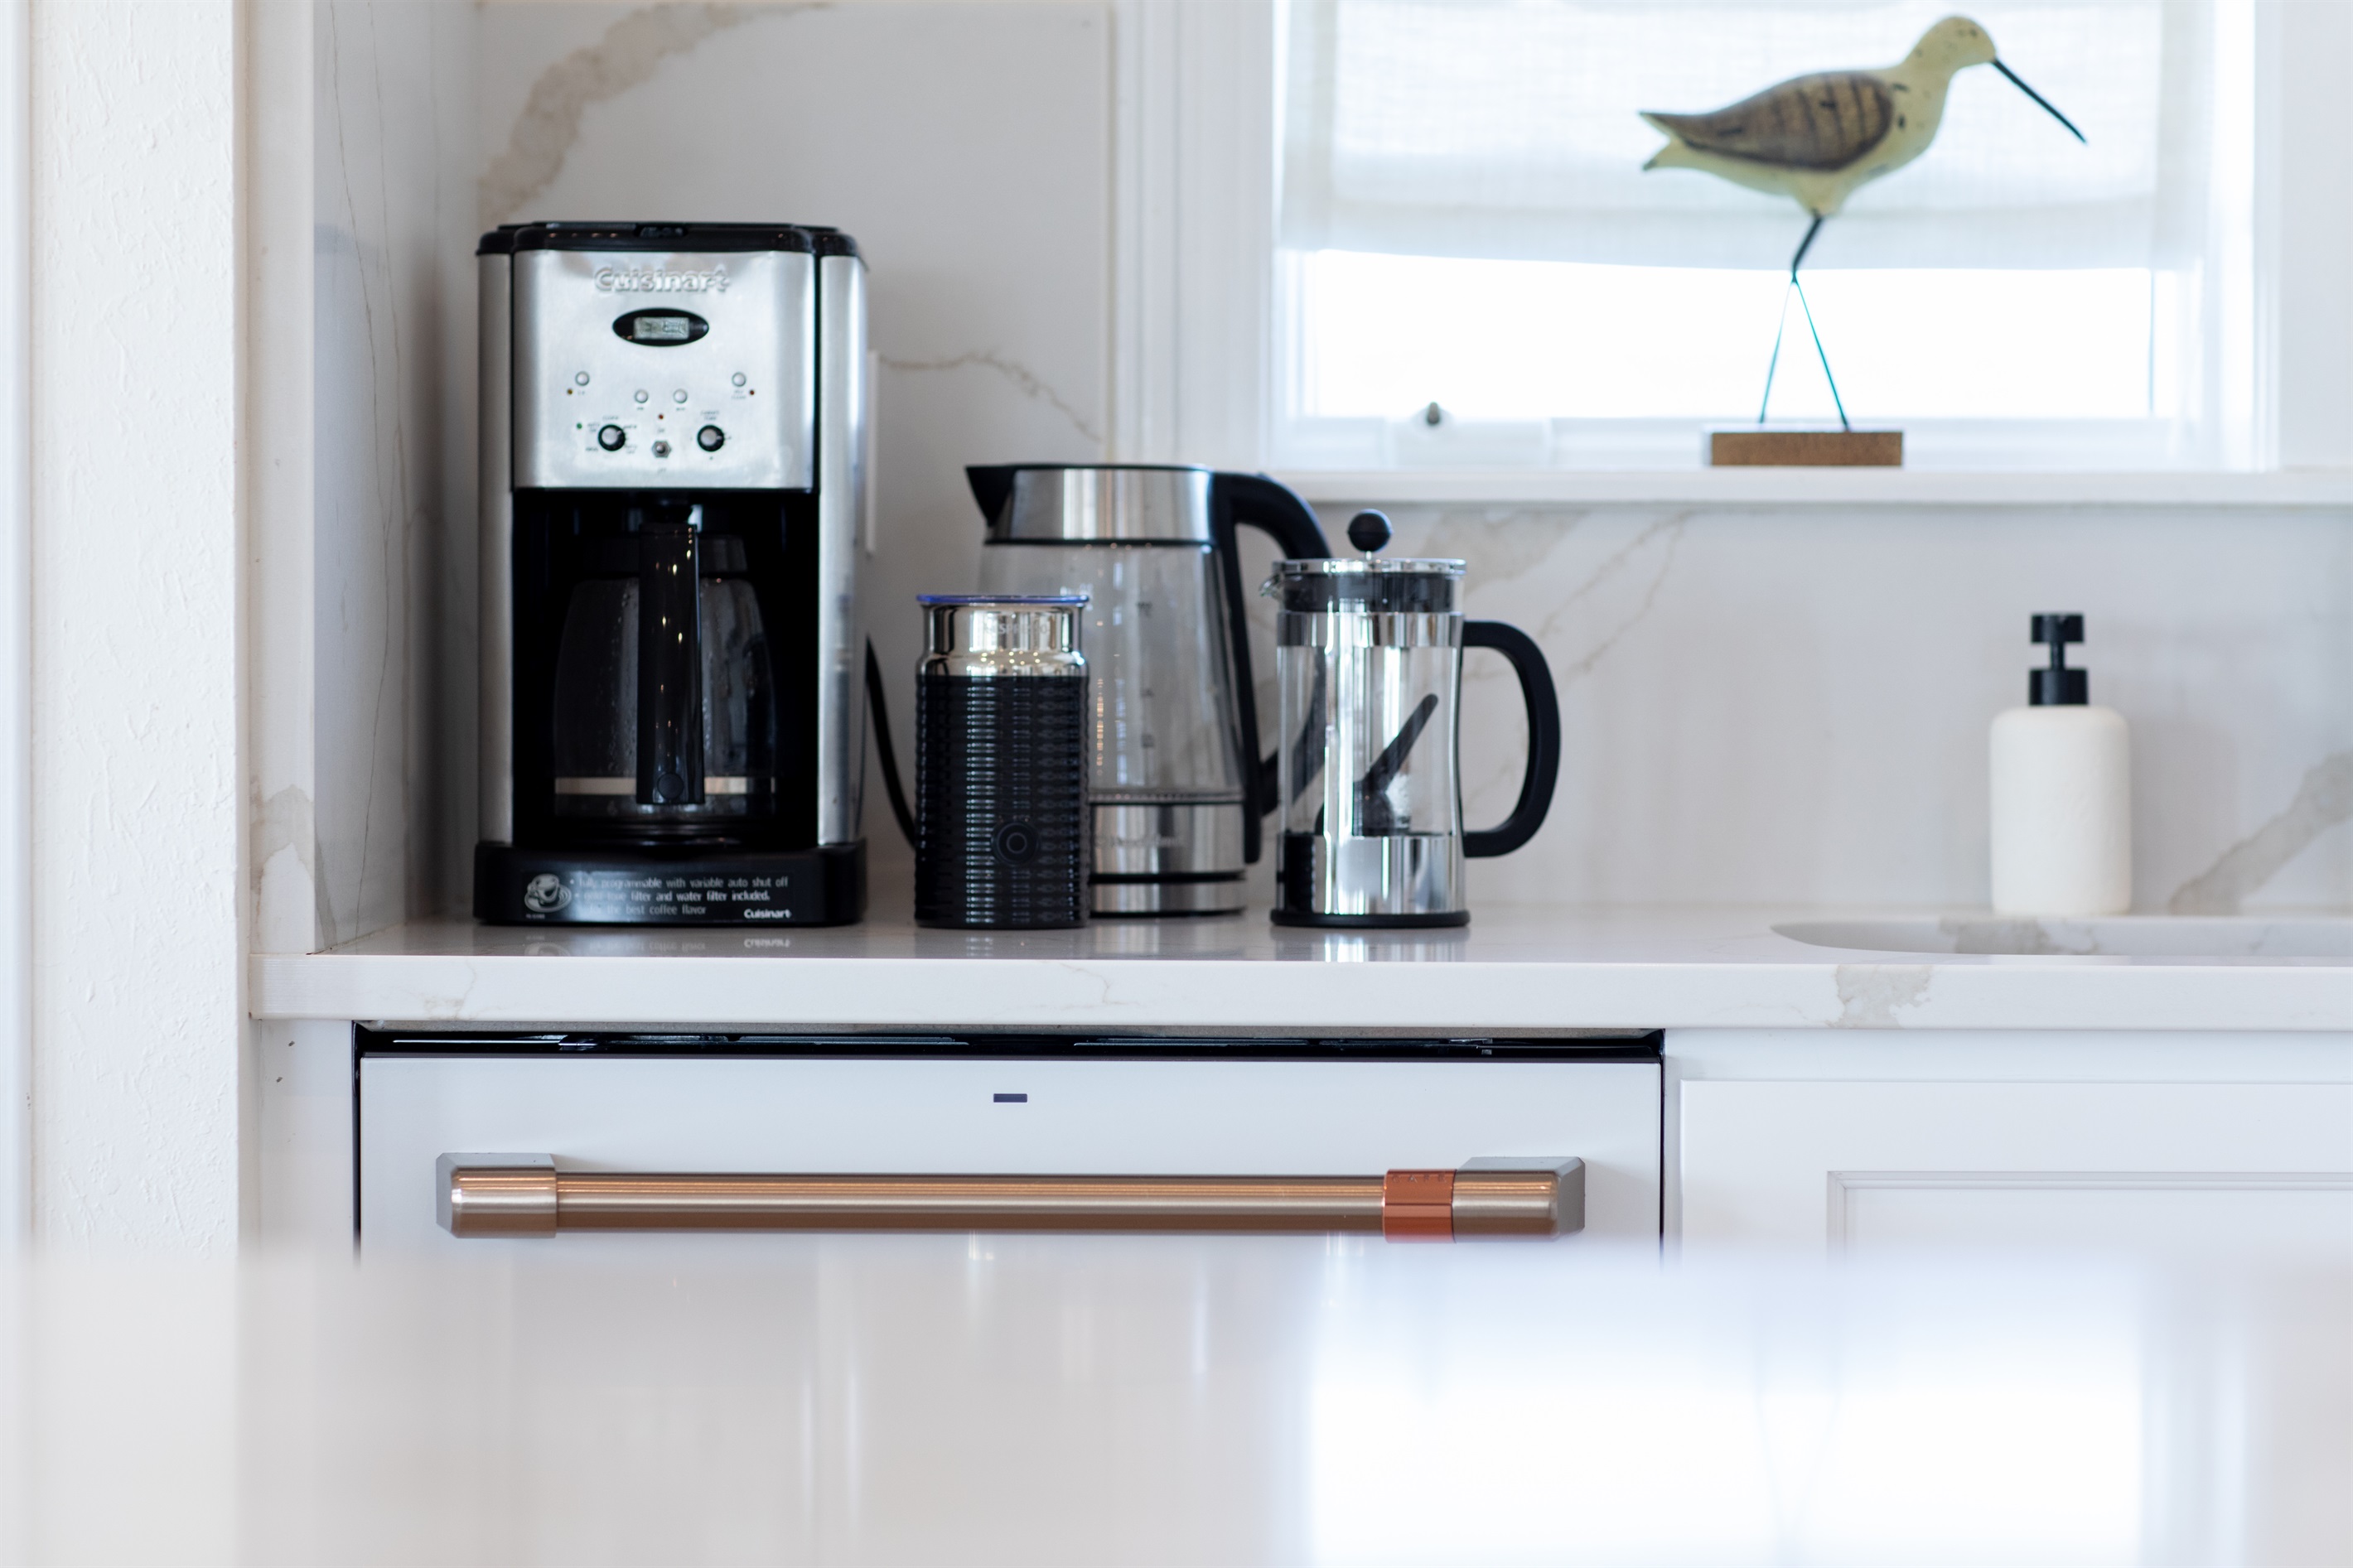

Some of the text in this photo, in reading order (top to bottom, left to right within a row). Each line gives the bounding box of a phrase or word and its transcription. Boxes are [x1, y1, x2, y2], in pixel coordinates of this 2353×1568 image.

[594, 266, 731, 292] Cuisinart
[601, 877, 663, 890] programmable
[666, 877, 686, 888] with
[689, 877, 724, 888] variable
[728, 877, 748, 888] auto
[752, 877, 771, 887] shut
[775, 876, 788, 887] off
[631, 890, 651, 901] filter
[655, 890, 673, 901] and
[676, 891, 702, 901] water
[707, 890, 727, 901] filter
[732, 890, 771, 901] included.
[626, 905, 645, 914] best
[650, 905, 678, 914] coffee
[682, 904, 707, 914] flavor
[743, 908, 792, 919] Cuisinart
